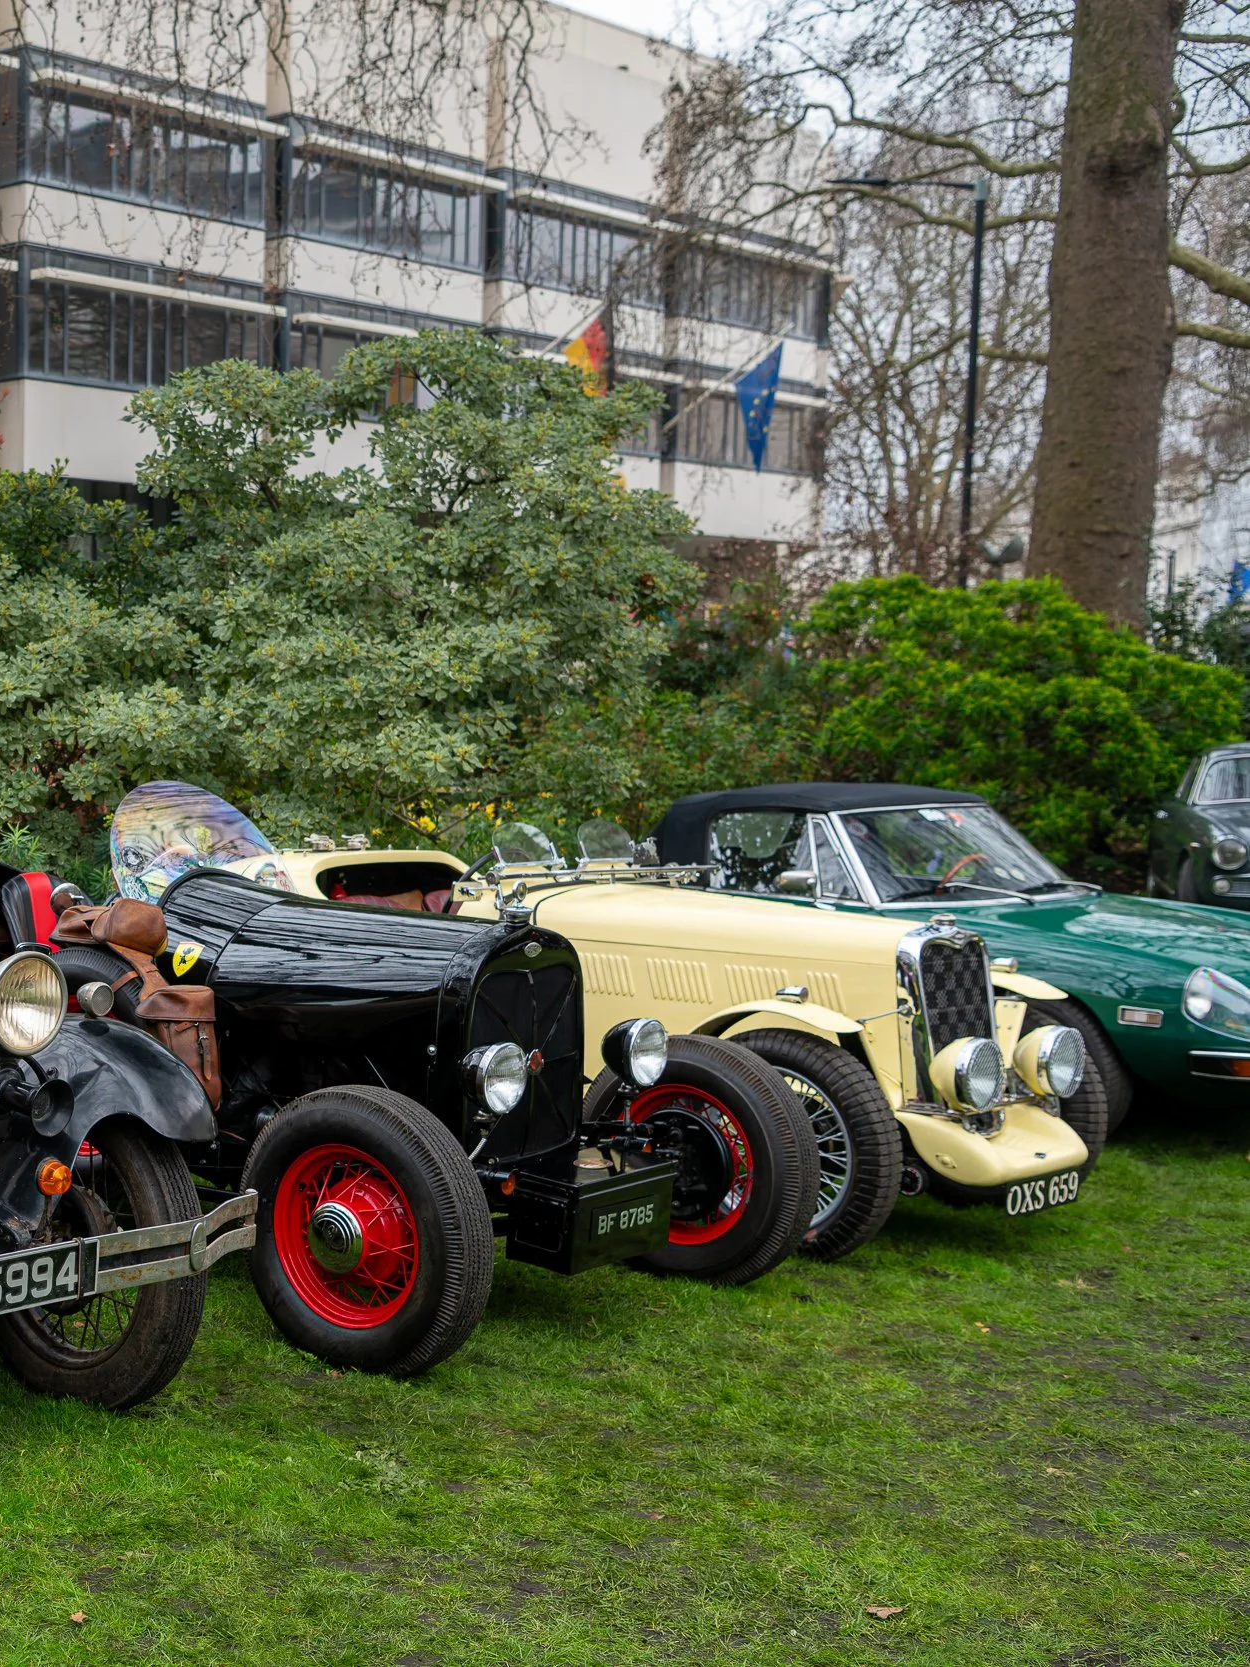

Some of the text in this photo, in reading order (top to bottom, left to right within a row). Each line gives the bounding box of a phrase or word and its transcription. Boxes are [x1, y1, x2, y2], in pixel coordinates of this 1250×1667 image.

[1006, 1171, 1079, 1216] OXS 659
[598, 1203, 654, 1235] BF 8785
